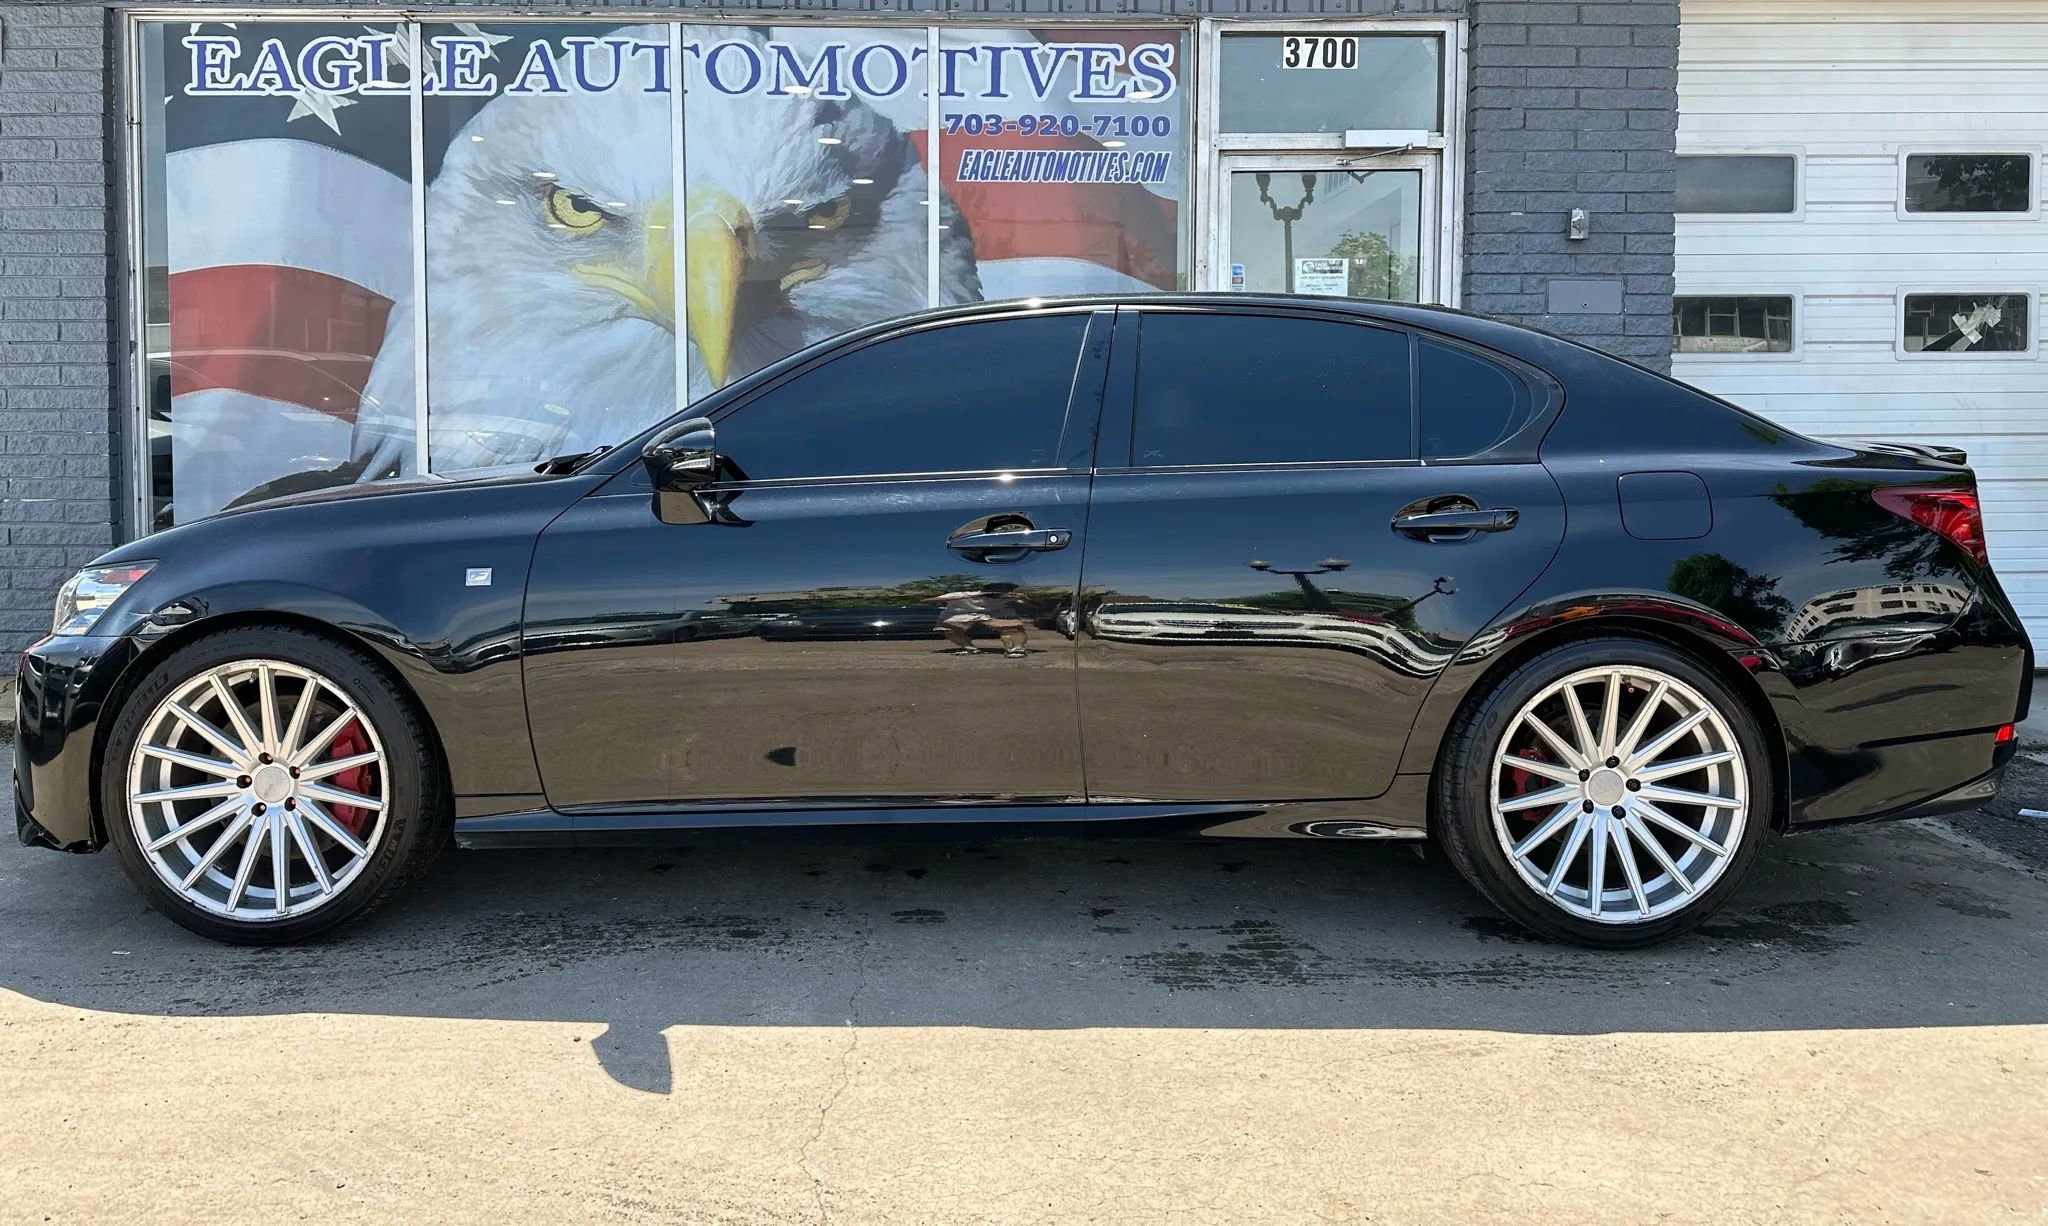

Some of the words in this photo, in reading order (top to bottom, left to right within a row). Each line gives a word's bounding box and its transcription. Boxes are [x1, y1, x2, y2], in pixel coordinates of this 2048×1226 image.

[1285, 37, 1356, 68] 3700
[186, 38, 496, 95] EAGLE
[508, 39, 1176, 102] AUTOMOTIVES
[944, 114, 1172, 137] 703-920-7100
[956, 150, 1173, 183] EAGLEAUTOMOTIVES.COM
